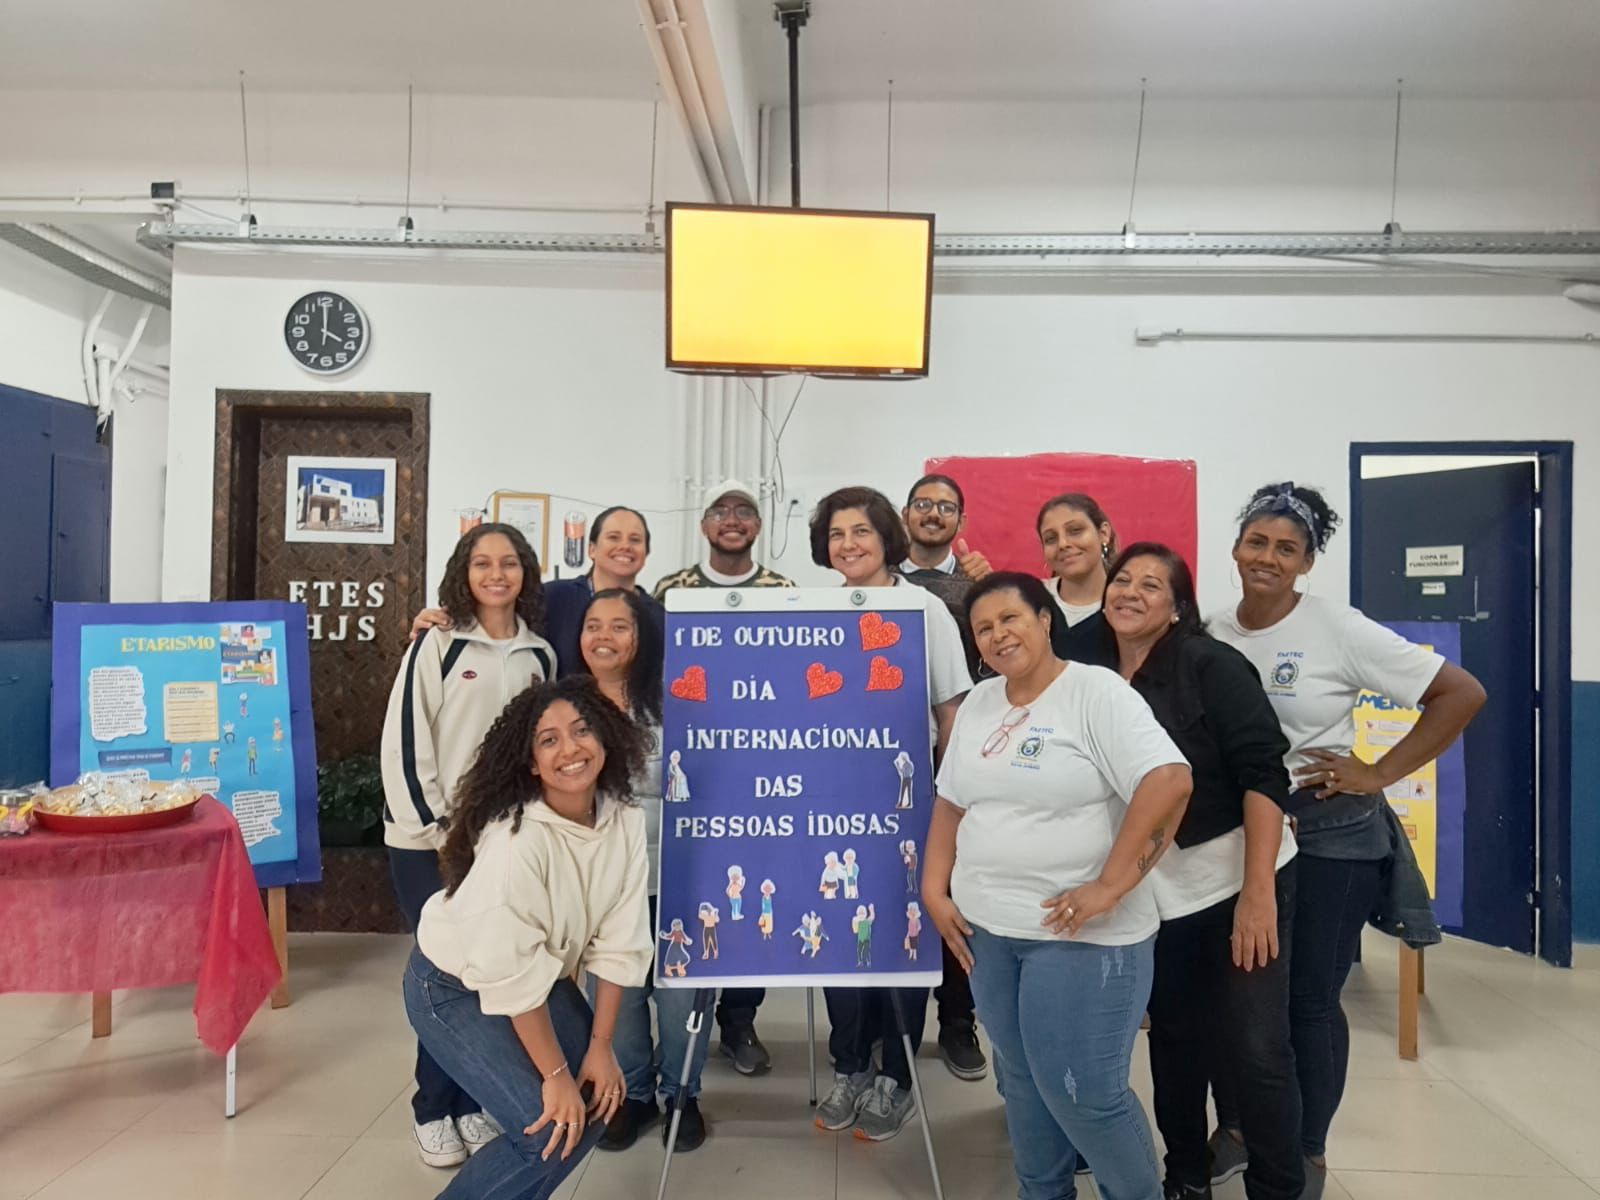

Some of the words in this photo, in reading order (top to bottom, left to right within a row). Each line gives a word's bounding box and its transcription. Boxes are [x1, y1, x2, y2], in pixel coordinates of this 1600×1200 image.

[317, 296, 334, 307] 12
[305, 303, 315, 313] 11
[295, 314, 310, 325] 10
[343, 312, 356, 323] 2
[292, 326, 306, 338] 9
[346, 327, 360, 338] 3
[296, 340, 309, 352] 8
[343, 340, 356, 351] 4
[306, 353, 318, 364] 7
[320, 356, 333, 367] 6
[335, 352, 347, 363] 5
[288, 581, 385, 608] ETES
[691, 626, 722, 647] DE
[734, 626, 845, 646] OUTUBRO
[121, 636, 215, 652] ETARISMO
[755, 775, 803, 798] DAS
[675, 815, 795, 838] PESSOAS
